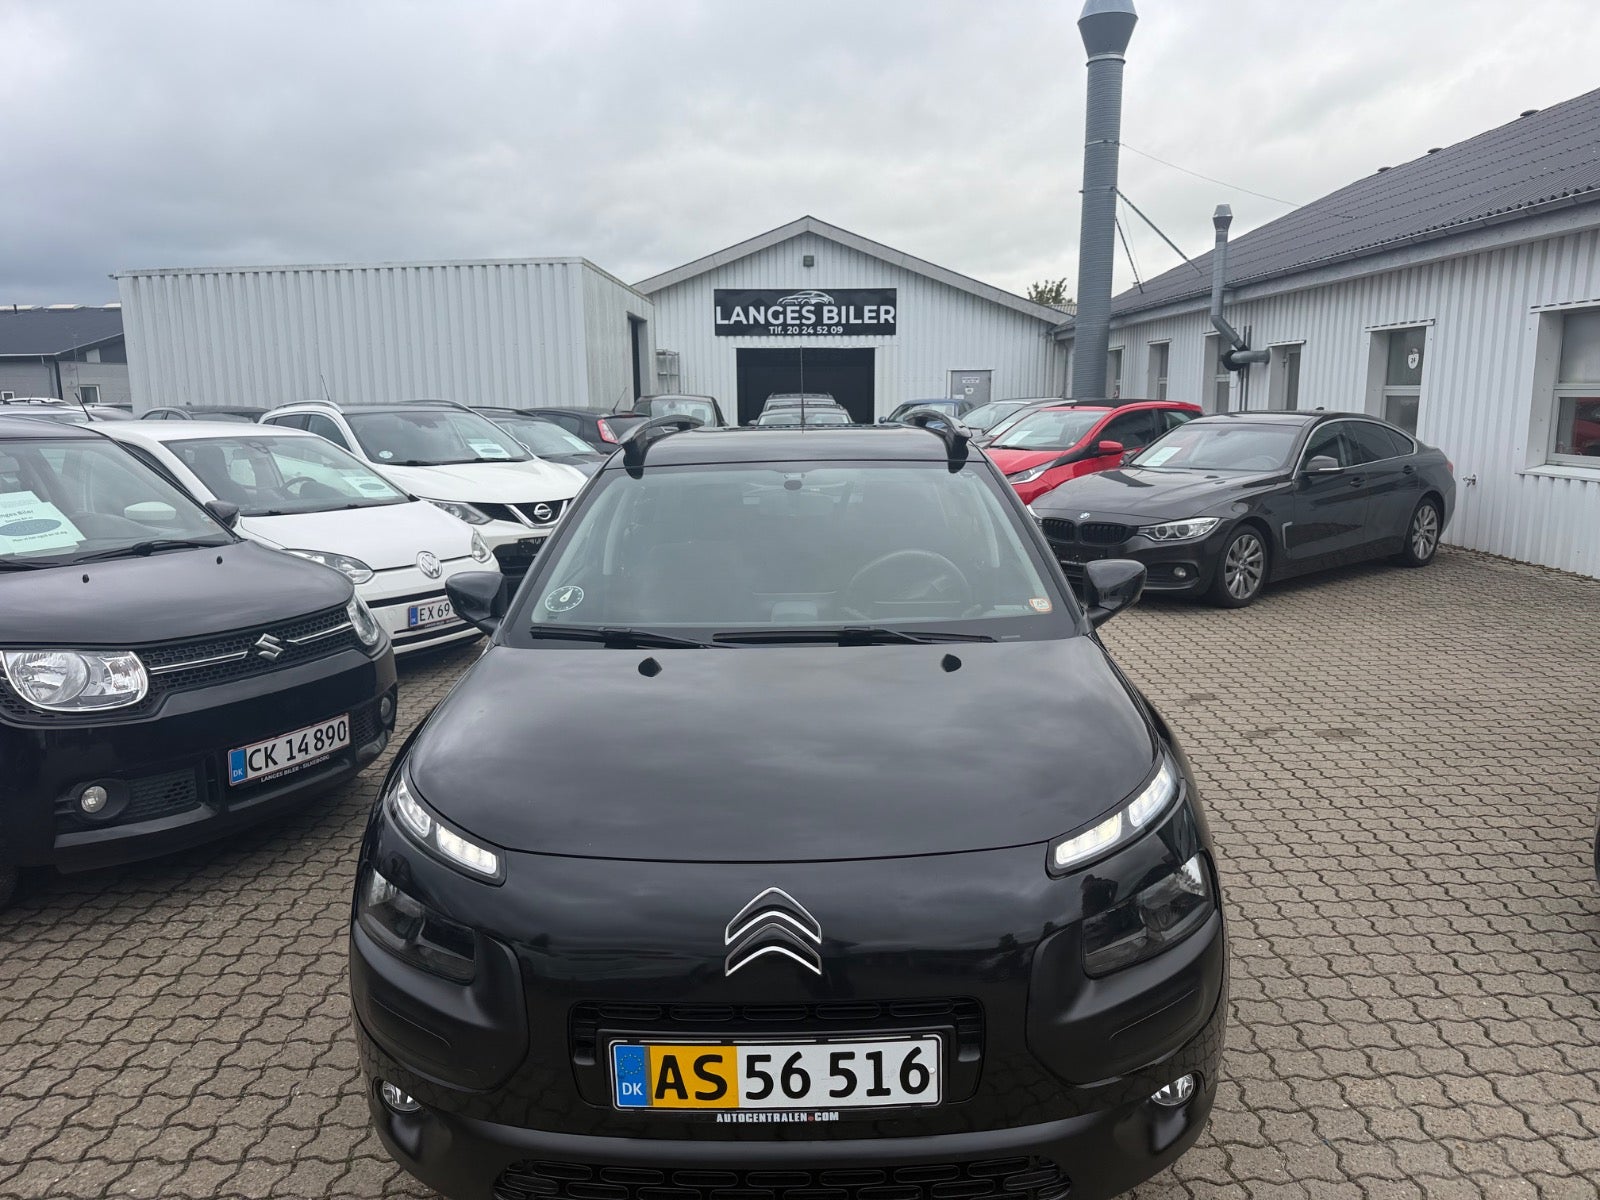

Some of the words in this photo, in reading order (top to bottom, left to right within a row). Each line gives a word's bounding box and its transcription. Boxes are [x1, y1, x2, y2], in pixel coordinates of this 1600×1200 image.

[715, 305, 816, 325] LANGES
[822, 305, 895, 324] BILER
[768, 326, 784, 334] Tlf.
[786, 326, 799, 334] 20
[801, 326, 814, 334] 24
[816, 326, 828, 334] 52
[830, 325, 843, 334] 09
[419, 606, 434, 621] EX
[437, 602, 450, 618] 69
[248, 743, 278, 772] CK
[285, 733, 309, 762] 14
[313, 720, 347, 752] 890
[232, 768, 243, 777] DK
[260, 770, 283, 783] LANGES
[283, 765, 300, 776] BILER
[654, 1054, 728, 1101] AS
[745, 1051, 811, 1100] 56
[829, 1046, 930, 1098] 516
[622, 1082, 643, 1096] DK
[716, 1112, 839, 1123] AUTOCENTRALEN.COM
